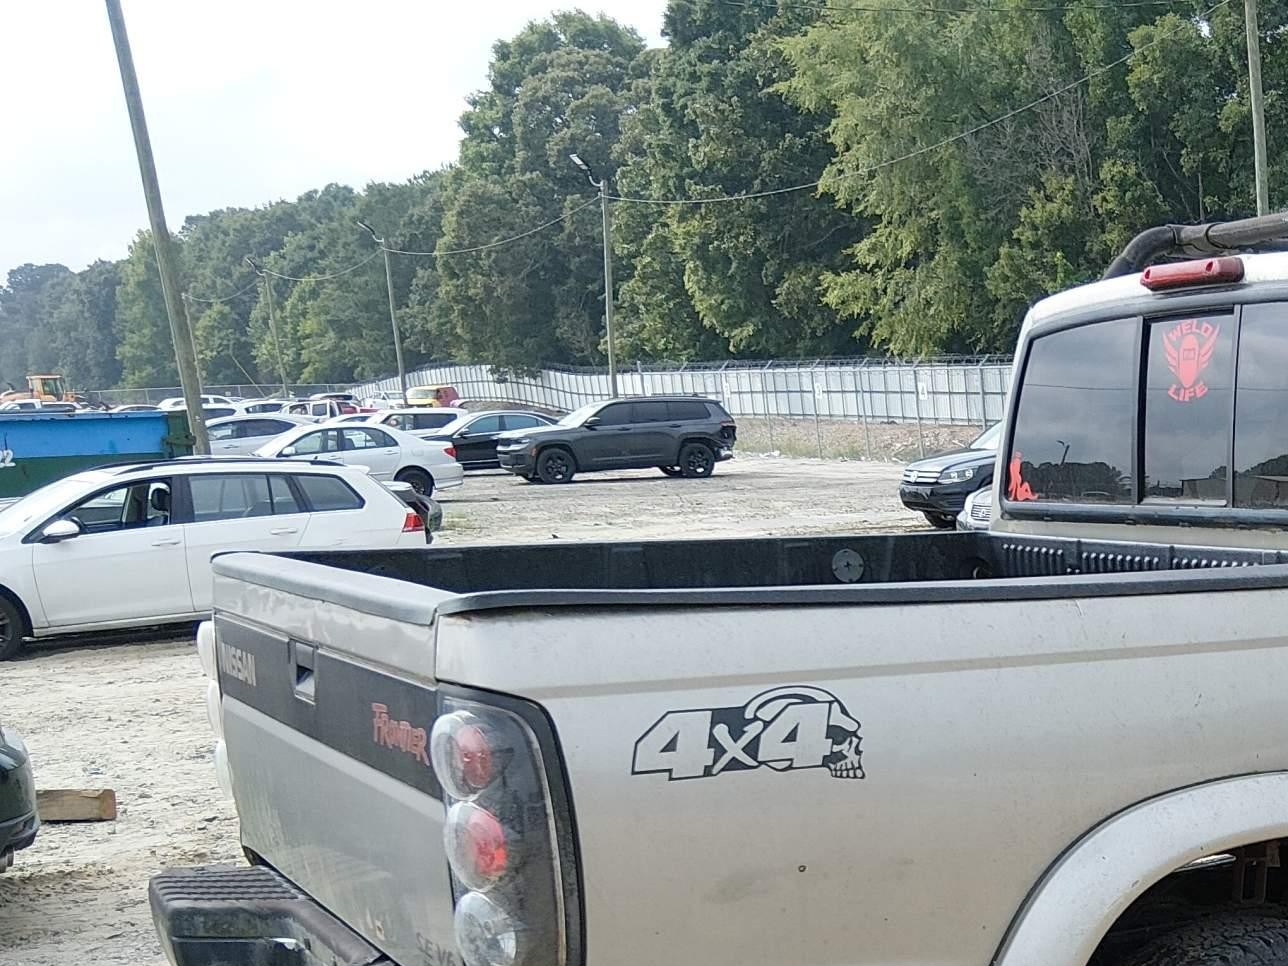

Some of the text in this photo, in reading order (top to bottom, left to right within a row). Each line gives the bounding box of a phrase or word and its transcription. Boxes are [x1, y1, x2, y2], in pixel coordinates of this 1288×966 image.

[1167, 319, 1213, 341] WELD
[1167, 381, 1208, 402] LIFE
[220, 641, 257, 687] NISSAN
